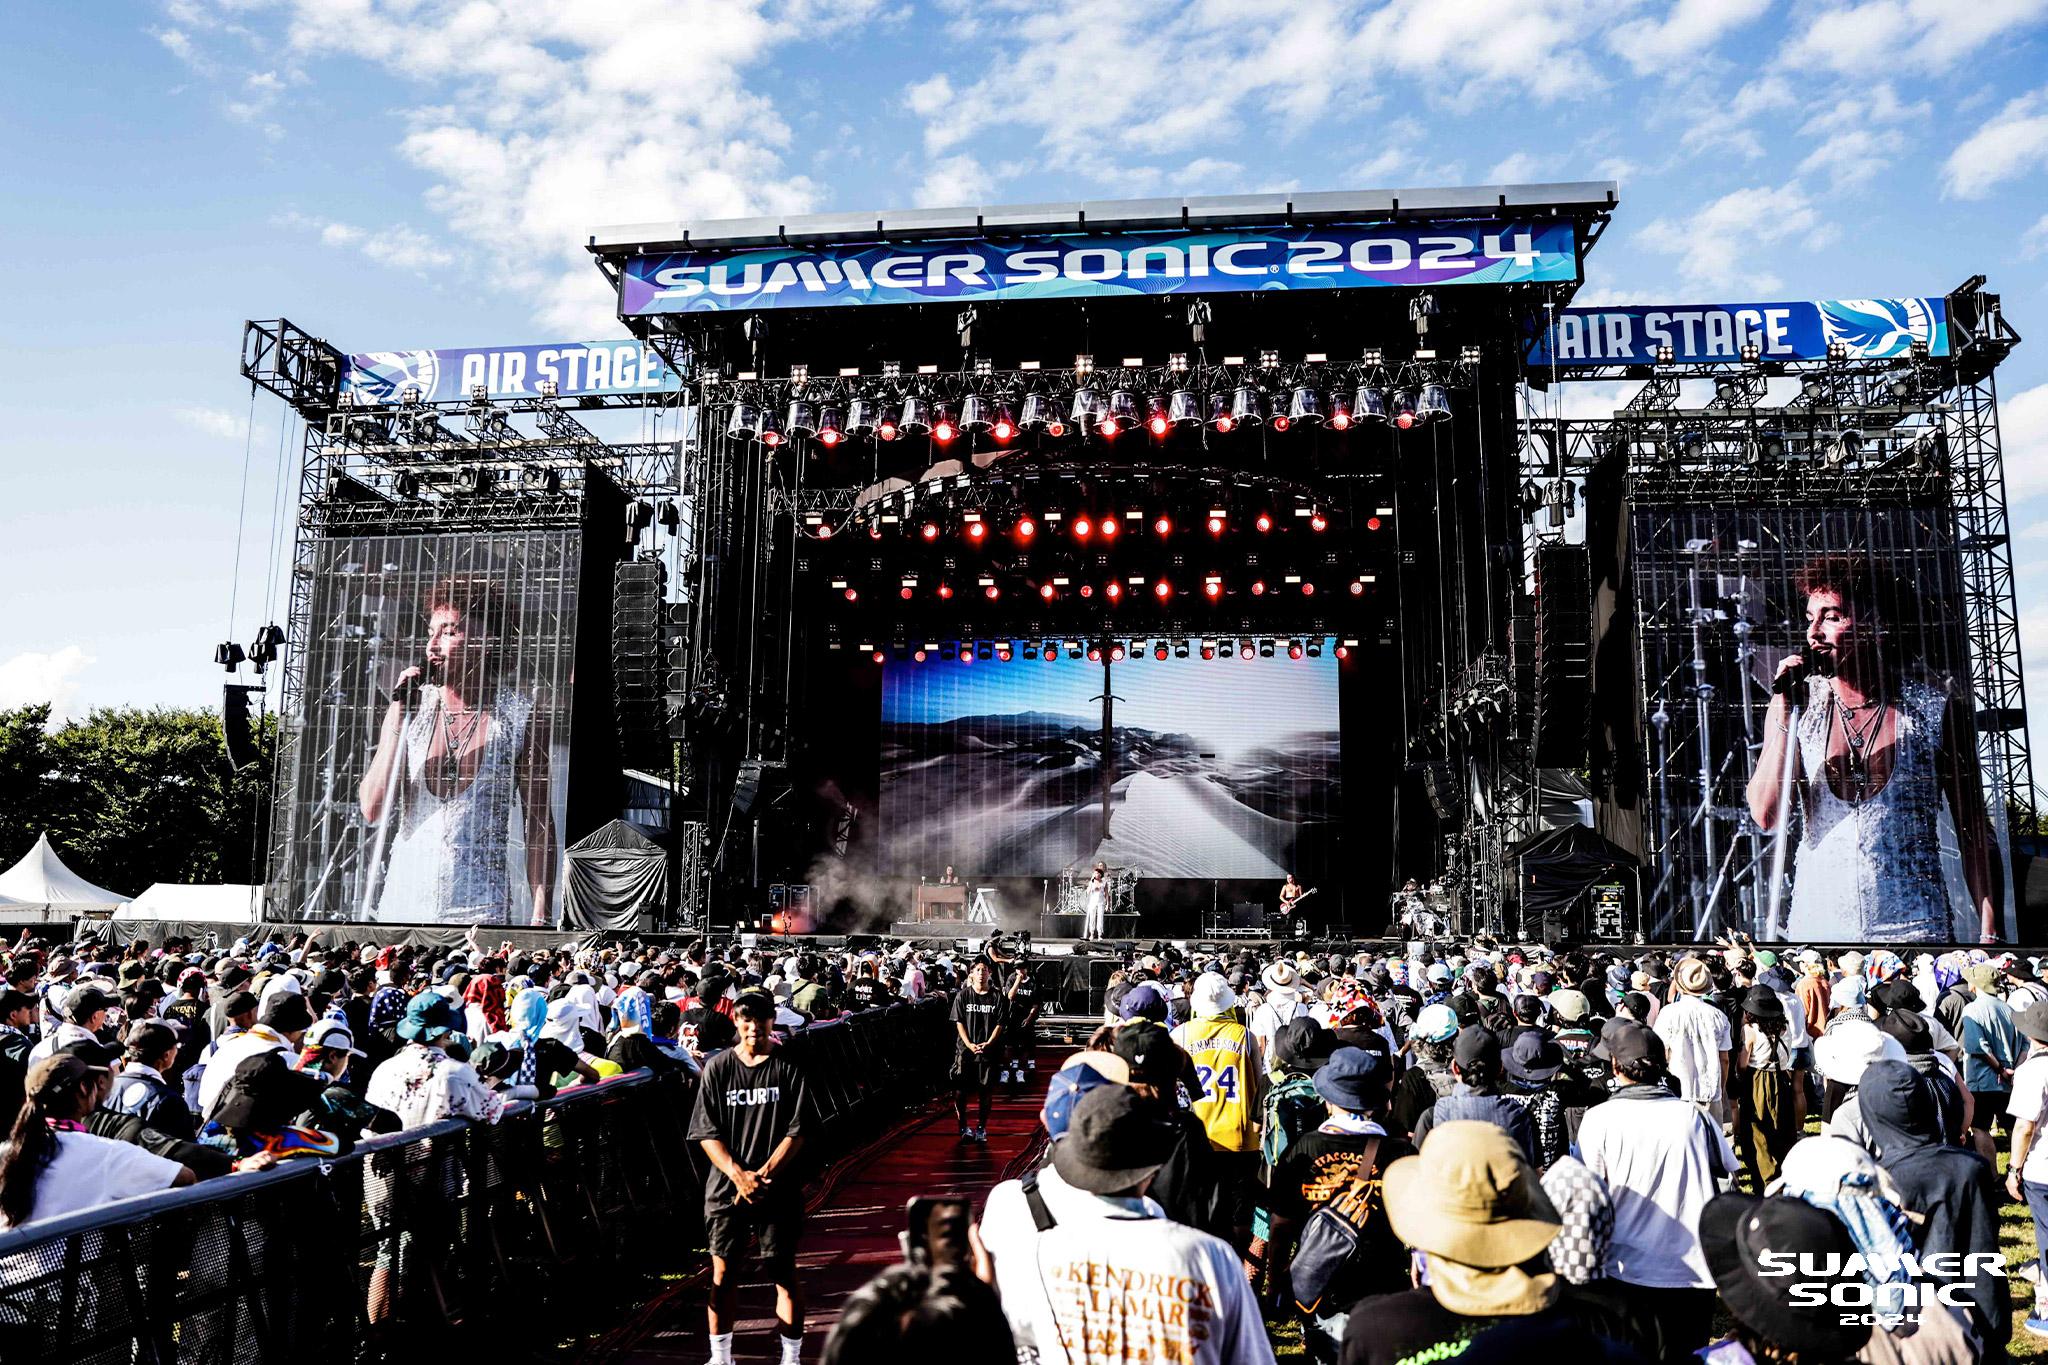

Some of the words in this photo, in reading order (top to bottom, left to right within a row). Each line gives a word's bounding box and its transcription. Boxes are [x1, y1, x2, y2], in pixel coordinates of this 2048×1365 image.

[654, 254, 988, 299] SUMMER
[1006, 242, 1268, 283] SONIC
[1288, 234, 1540, 274] 2024
[1560, 313, 1635, 359] AIR
[1645, 308, 1793, 357] STAGE
[460, 352, 527, 397] AIR
[536, 347, 661, 394] STAGE
[966, 1003, 996, 1013] SECURITY
[1196, 1065, 1238, 1100] 24
[1068, 1261, 1213, 1309] KENDRICK
